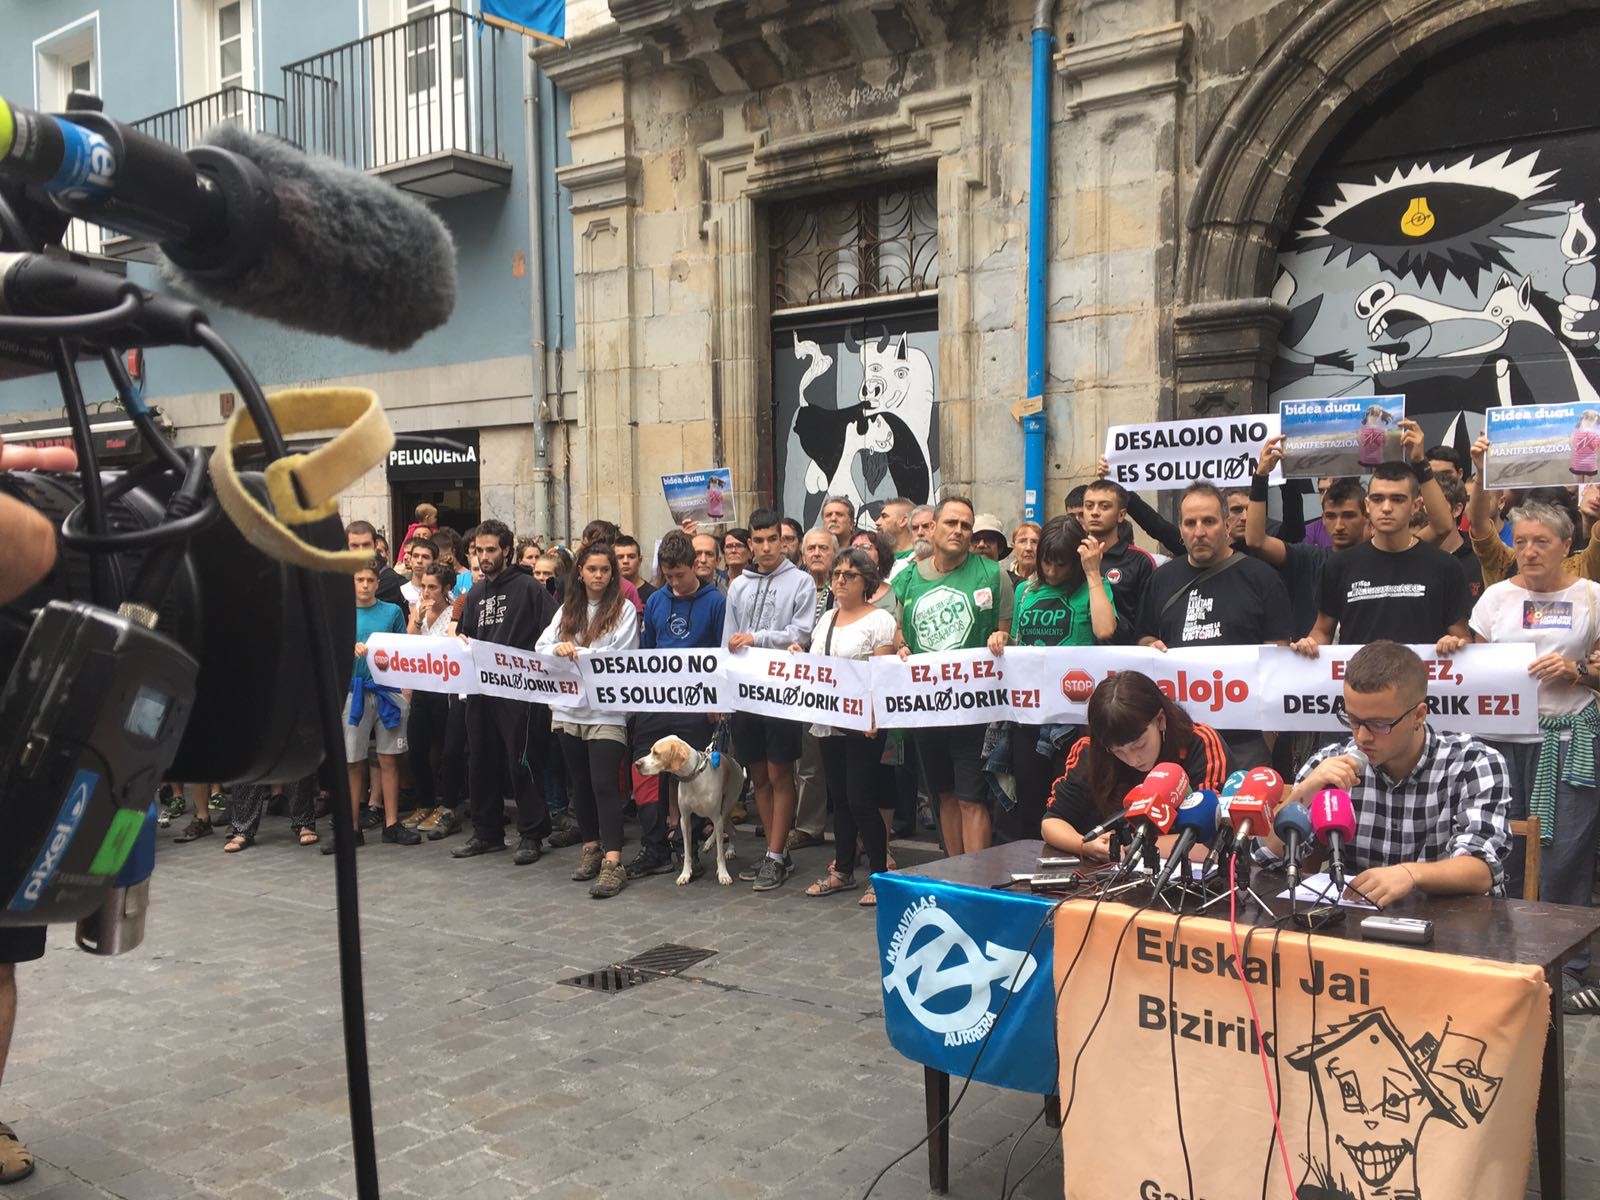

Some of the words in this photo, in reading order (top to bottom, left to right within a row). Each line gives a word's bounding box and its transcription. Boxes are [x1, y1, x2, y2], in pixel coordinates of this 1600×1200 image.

[1285, 404, 1322, 416] bidea
[1491, 410, 1532, 422] bidea
[1115, 425, 1223, 451] DESALOJO
[1230, 422, 1268, 444] NO
[1285, 440, 1359, 450] MANIFESTAZIOA
[1490, 444, 1571, 456] MANIFESTAZIOA
[663, 477, 682, 485] bidea
[1117, 464, 1139, 483] ES
[918, 601, 964, 638] STOP
[1020, 609, 1066, 626] STOP
[390, 651, 460, 682] desalojo
[495, 652, 512, 670] EZ,
[512, 655, 530, 672] EZ,
[590, 655, 683, 674] DESALOJO
[688, 655, 718, 673] NO
[768, 661, 790, 681] EZ,
[794, 664, 815, 684] EZ,
[818, 666, 837, 688] EZ,
[911, 665, 938, 685] EZ,
[941, 663, 969, 682] EZ,
[972, 660, 1004, 681] EZ,
[559, 680, 579, 695] EZ!
[596, 686, 617, 703] ES
[1064, 680, 1093, 692] STOP
[843, 698, 863, 716] EZ!
[1011, 690, 1041, 708] EZ!
[1478, 694, 1520, 716] EZ!
[24, 824, 73, 900] pixel
[885, 895, 937, 966] MARAVILLAS
[1136, 926, 1281, 988] Euskal
[1299, 960, 1370, 1005] Jai
[944, 1011, 998, 1047] AURRERA
[1138, 994, 1276, 1058] Bizirik
